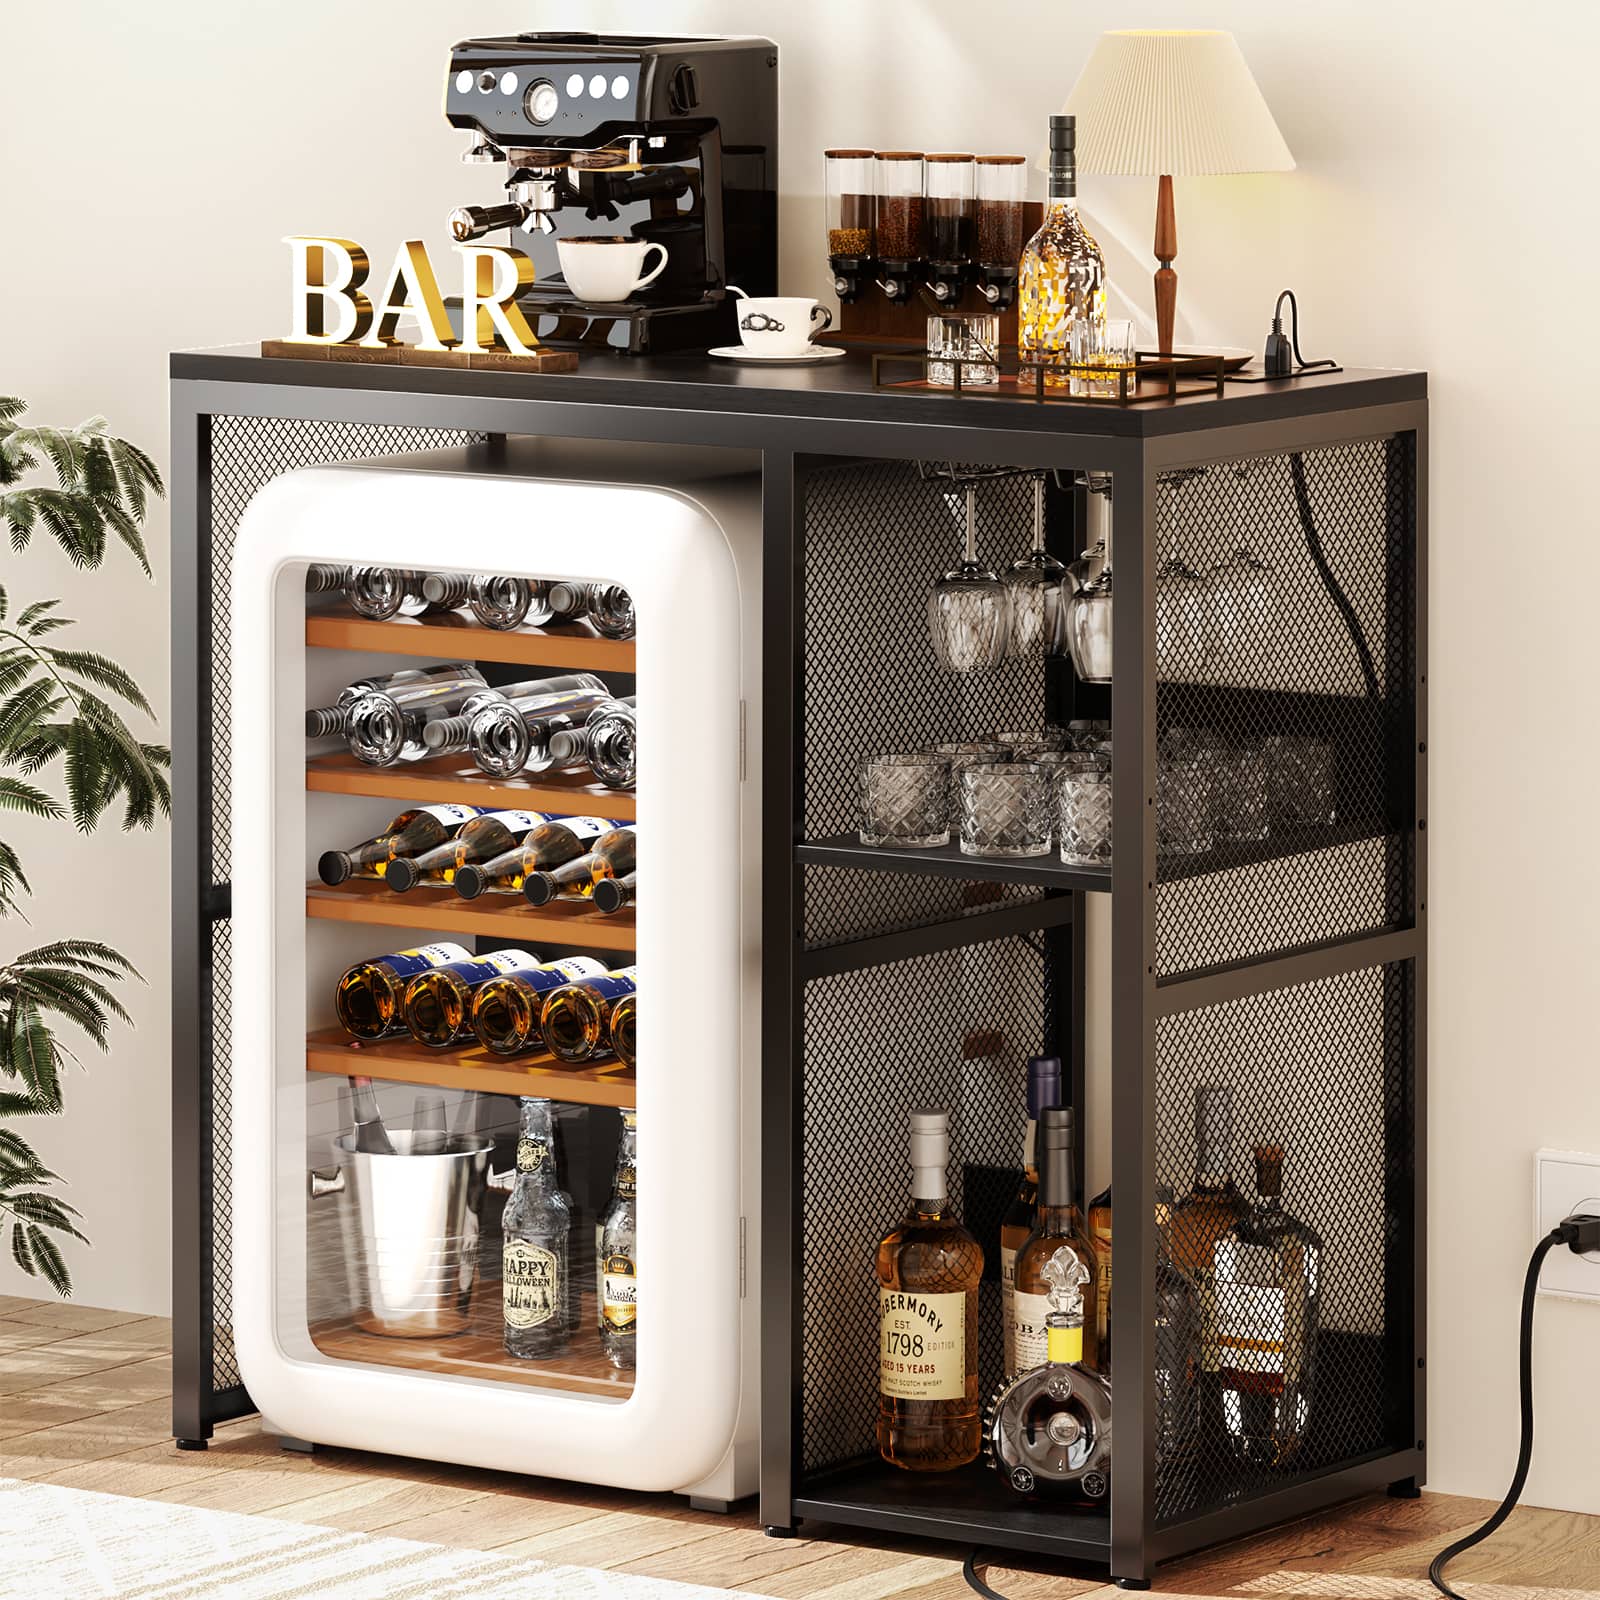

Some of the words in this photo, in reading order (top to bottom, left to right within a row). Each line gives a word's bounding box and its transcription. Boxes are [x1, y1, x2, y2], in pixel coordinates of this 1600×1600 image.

[281, 235, 544, 356] BAR
[887, 1331, 924, 1358] 1798
[896, 1363, 904, 1373] 15
[907, 1364, 936, 1374] YEARS
